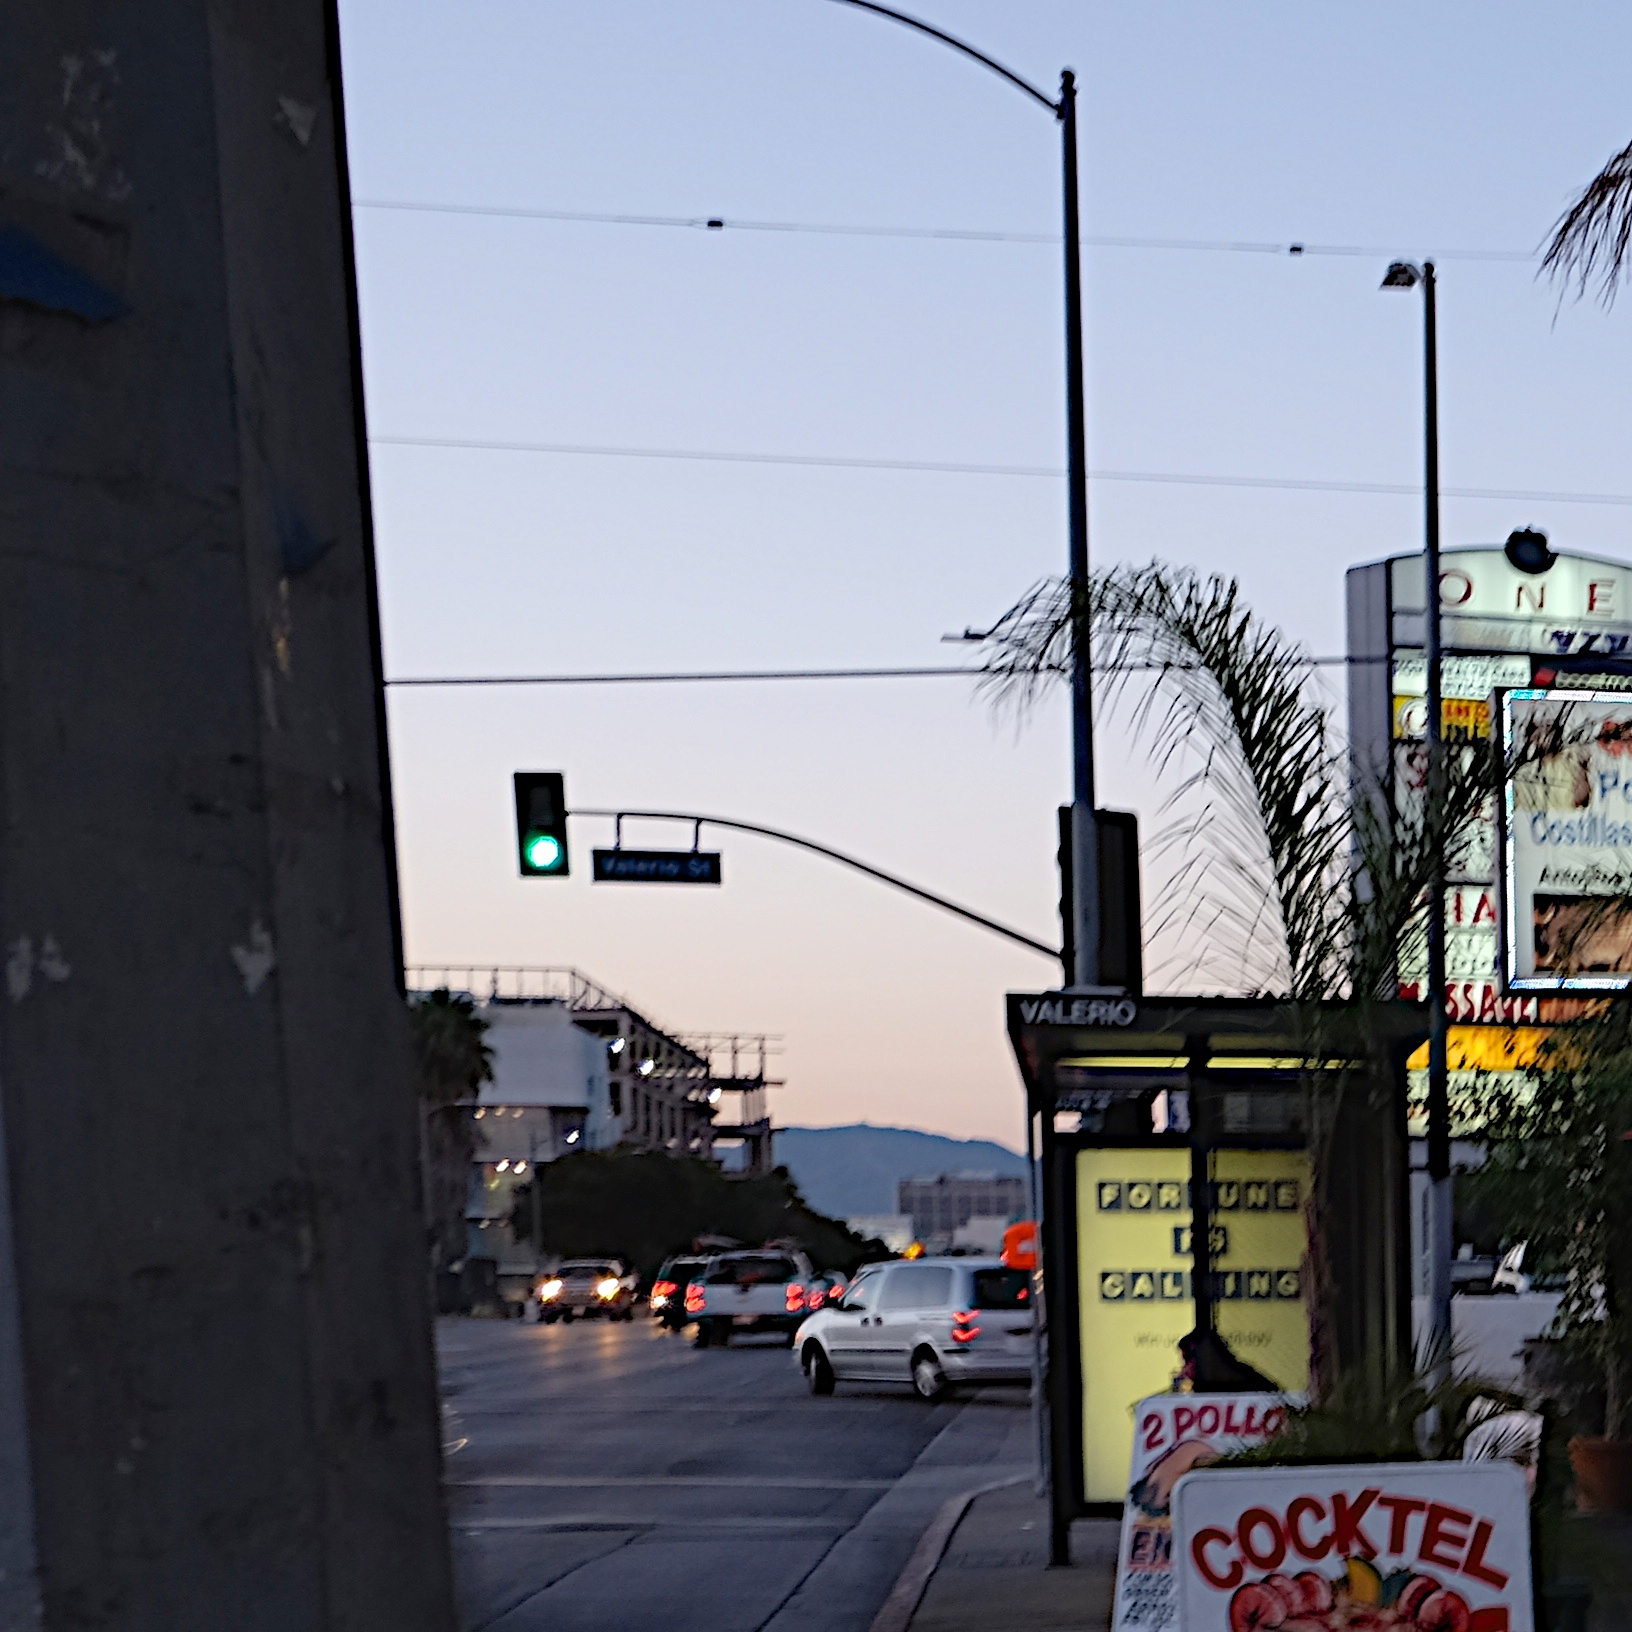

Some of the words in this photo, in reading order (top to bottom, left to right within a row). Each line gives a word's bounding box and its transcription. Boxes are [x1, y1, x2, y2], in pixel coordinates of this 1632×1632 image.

[1529, 811, 1632, 848] Costillas
[1020, 999, 1138, 1027] VALERIO
[1099, 1181, 1299, 1210] FORUNE
[1101, 1271, 1300, 1299] CALING
[1143, 1414, 1164, 1449] 2
[1192, 1489, 1510, 1590] COCKTEL
